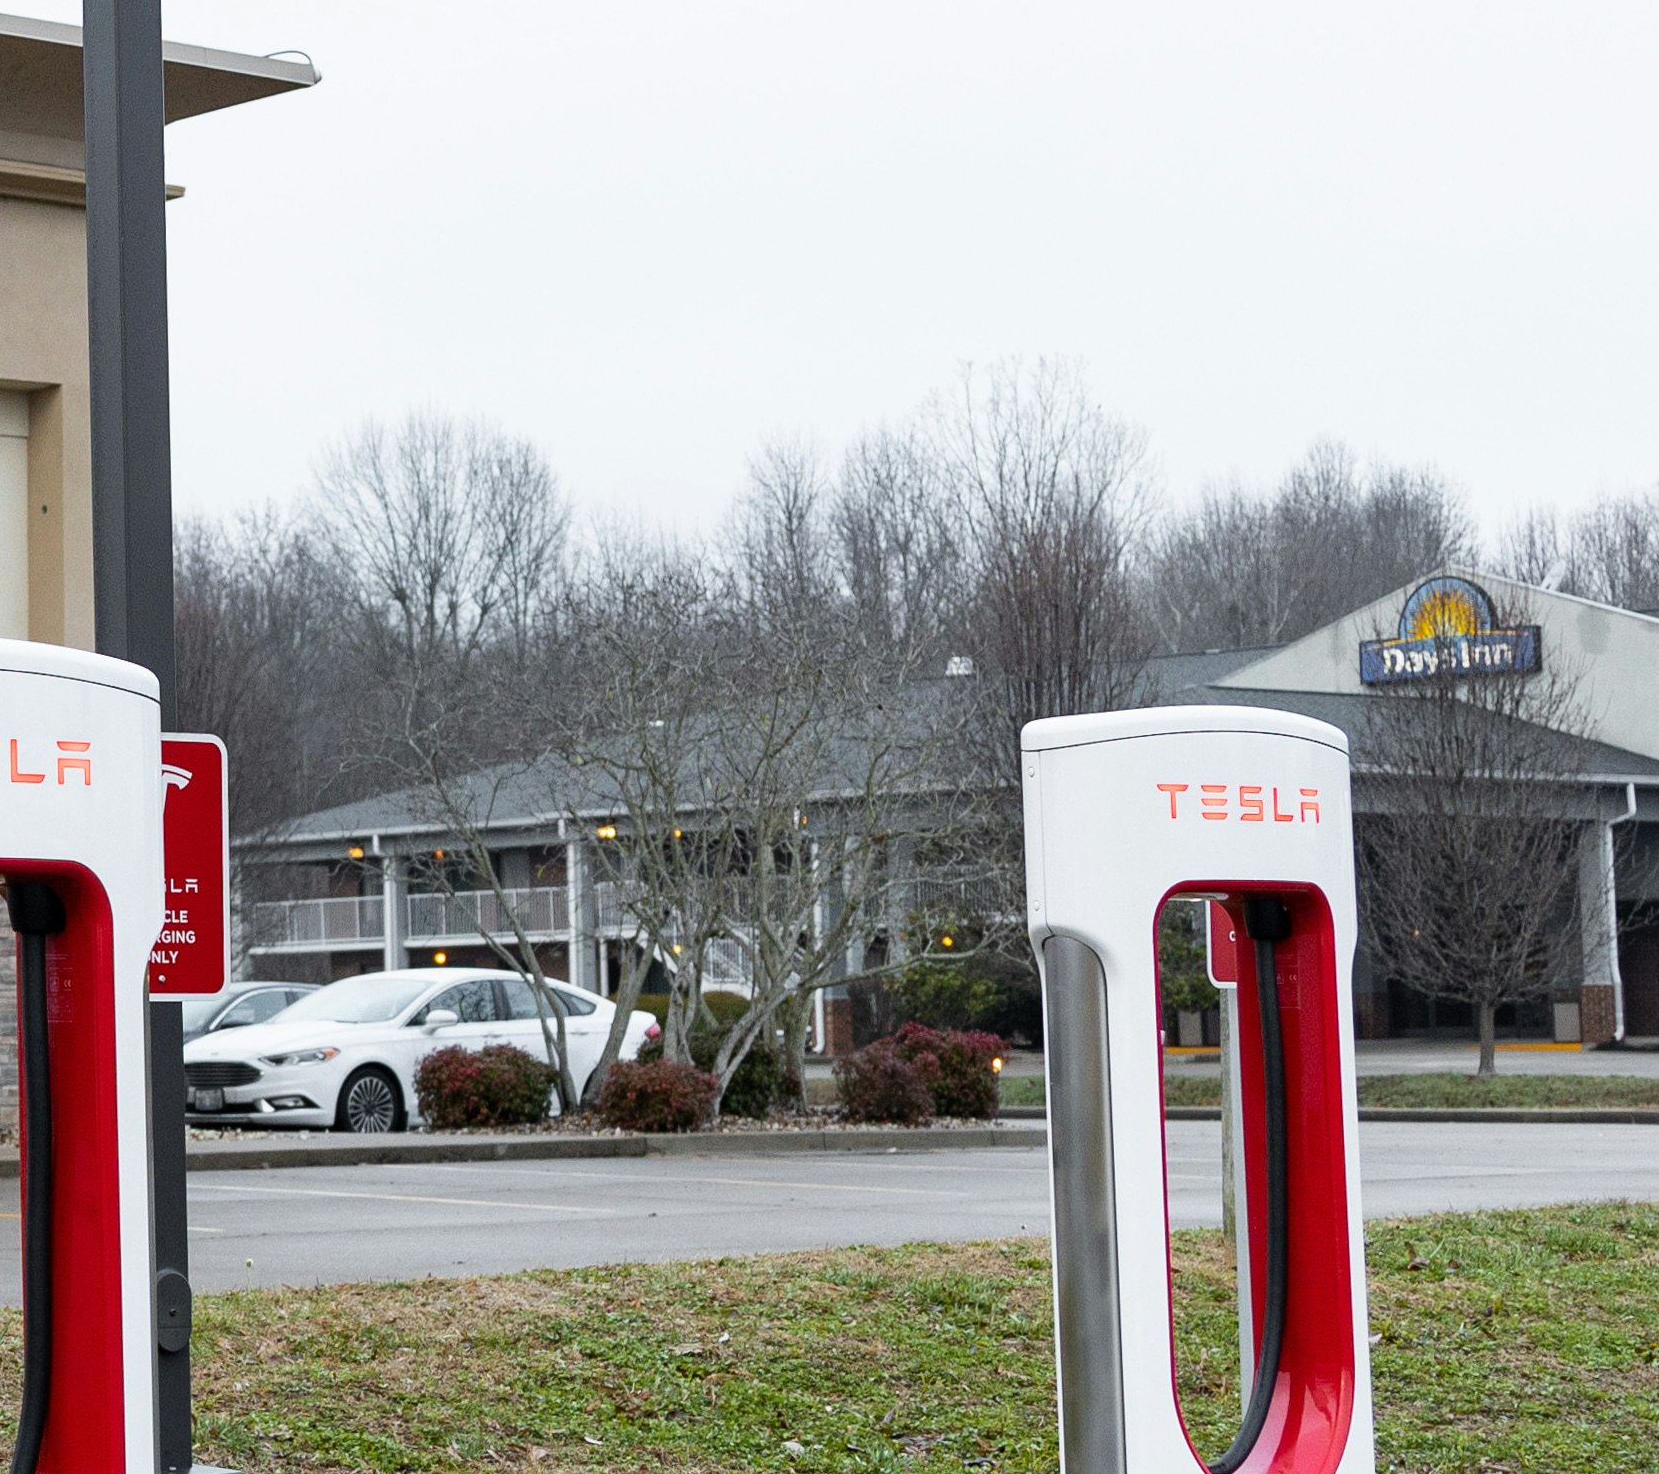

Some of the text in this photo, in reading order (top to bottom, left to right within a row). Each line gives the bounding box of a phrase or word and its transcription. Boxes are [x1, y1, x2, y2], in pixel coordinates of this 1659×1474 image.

[1460, 640, 1512, 669] Inn
[1156, 783, 1320, 824] TESLA
[148, 950, 179, 964] NLY
